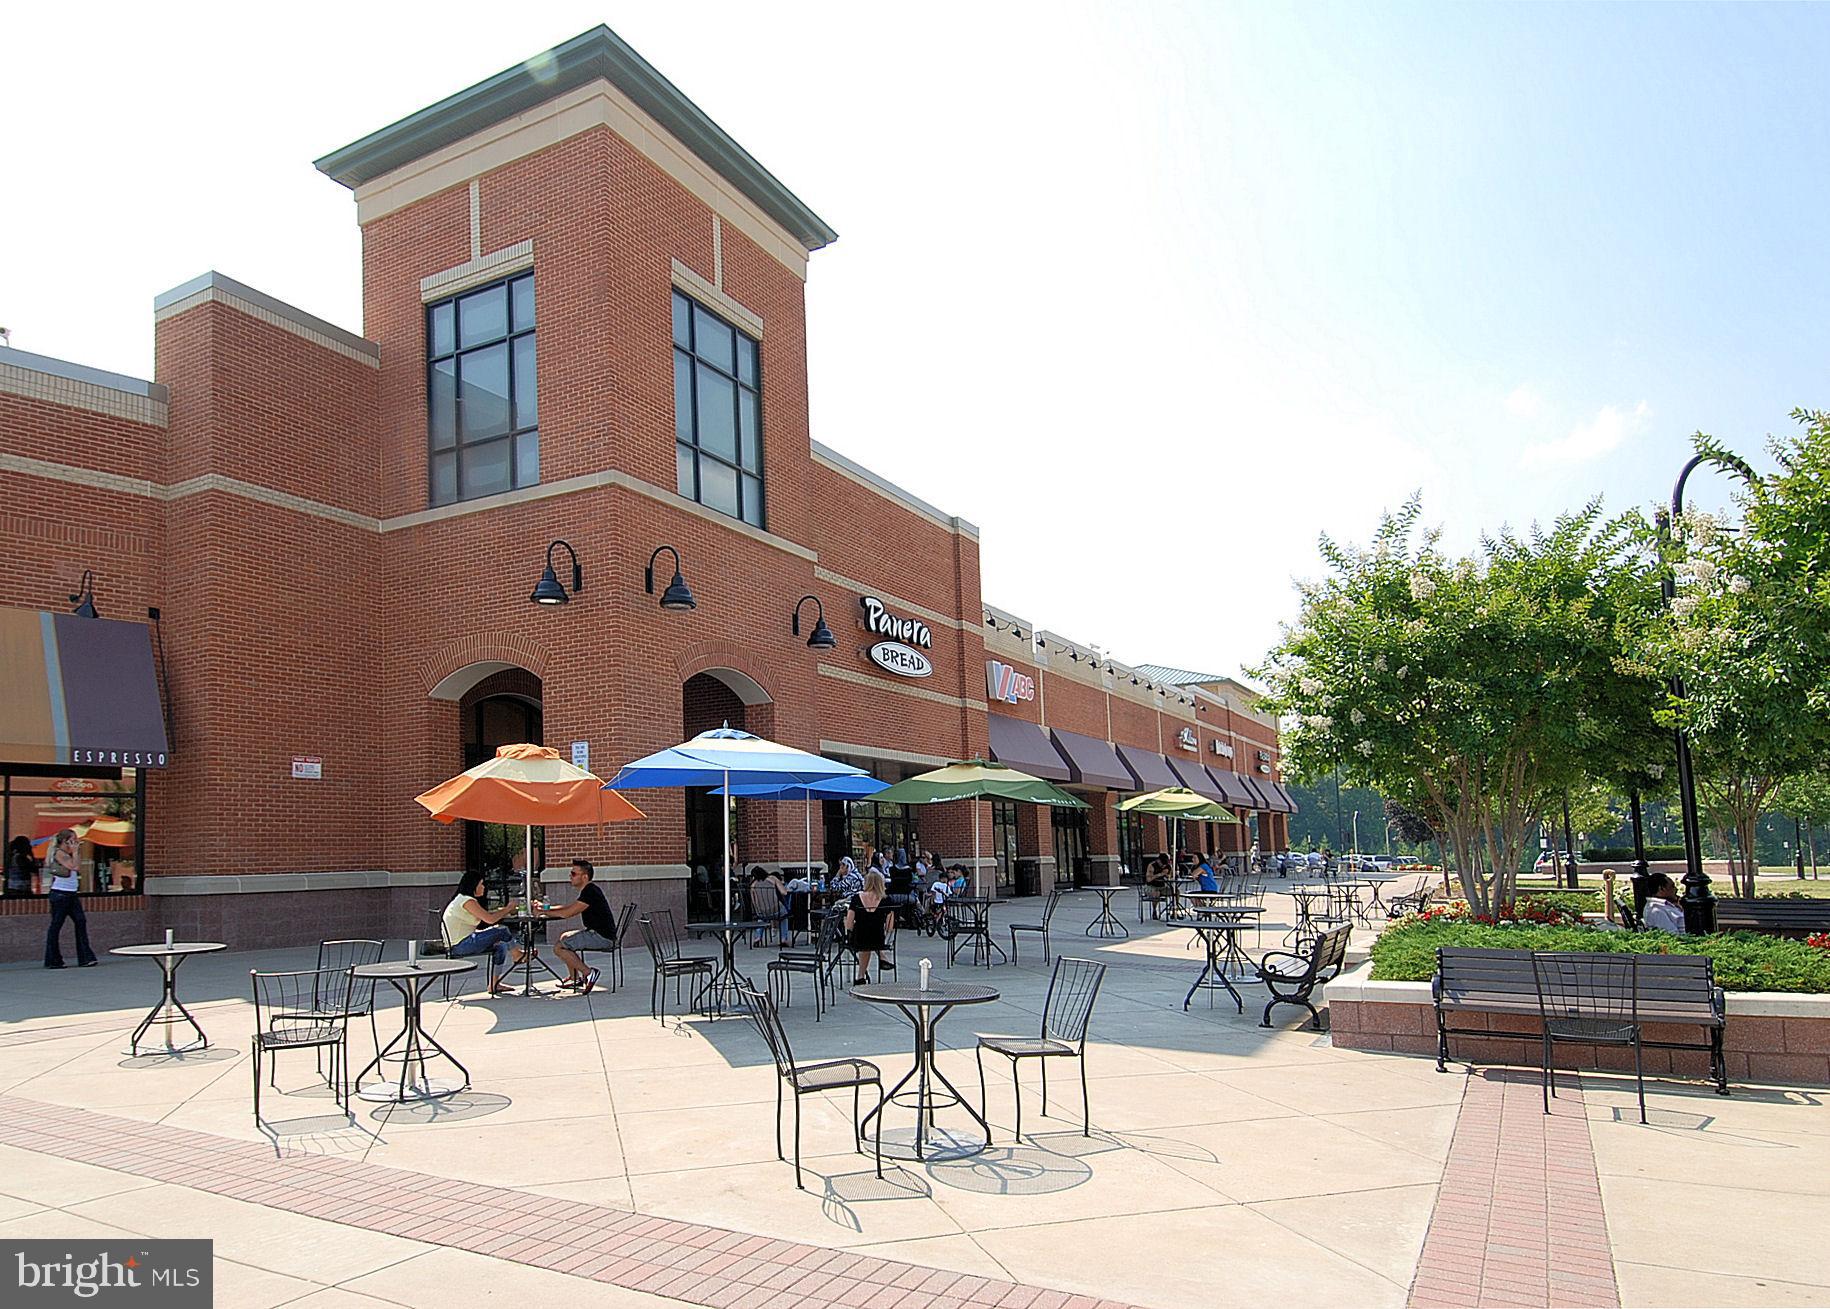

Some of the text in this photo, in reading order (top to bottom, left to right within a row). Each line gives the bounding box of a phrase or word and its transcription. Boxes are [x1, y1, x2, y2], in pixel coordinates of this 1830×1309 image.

[863, 596, 932, 649] Panera
[881, 647, 924, 670] BREAD
[73, 750, 165, 765] ESPRESSO
